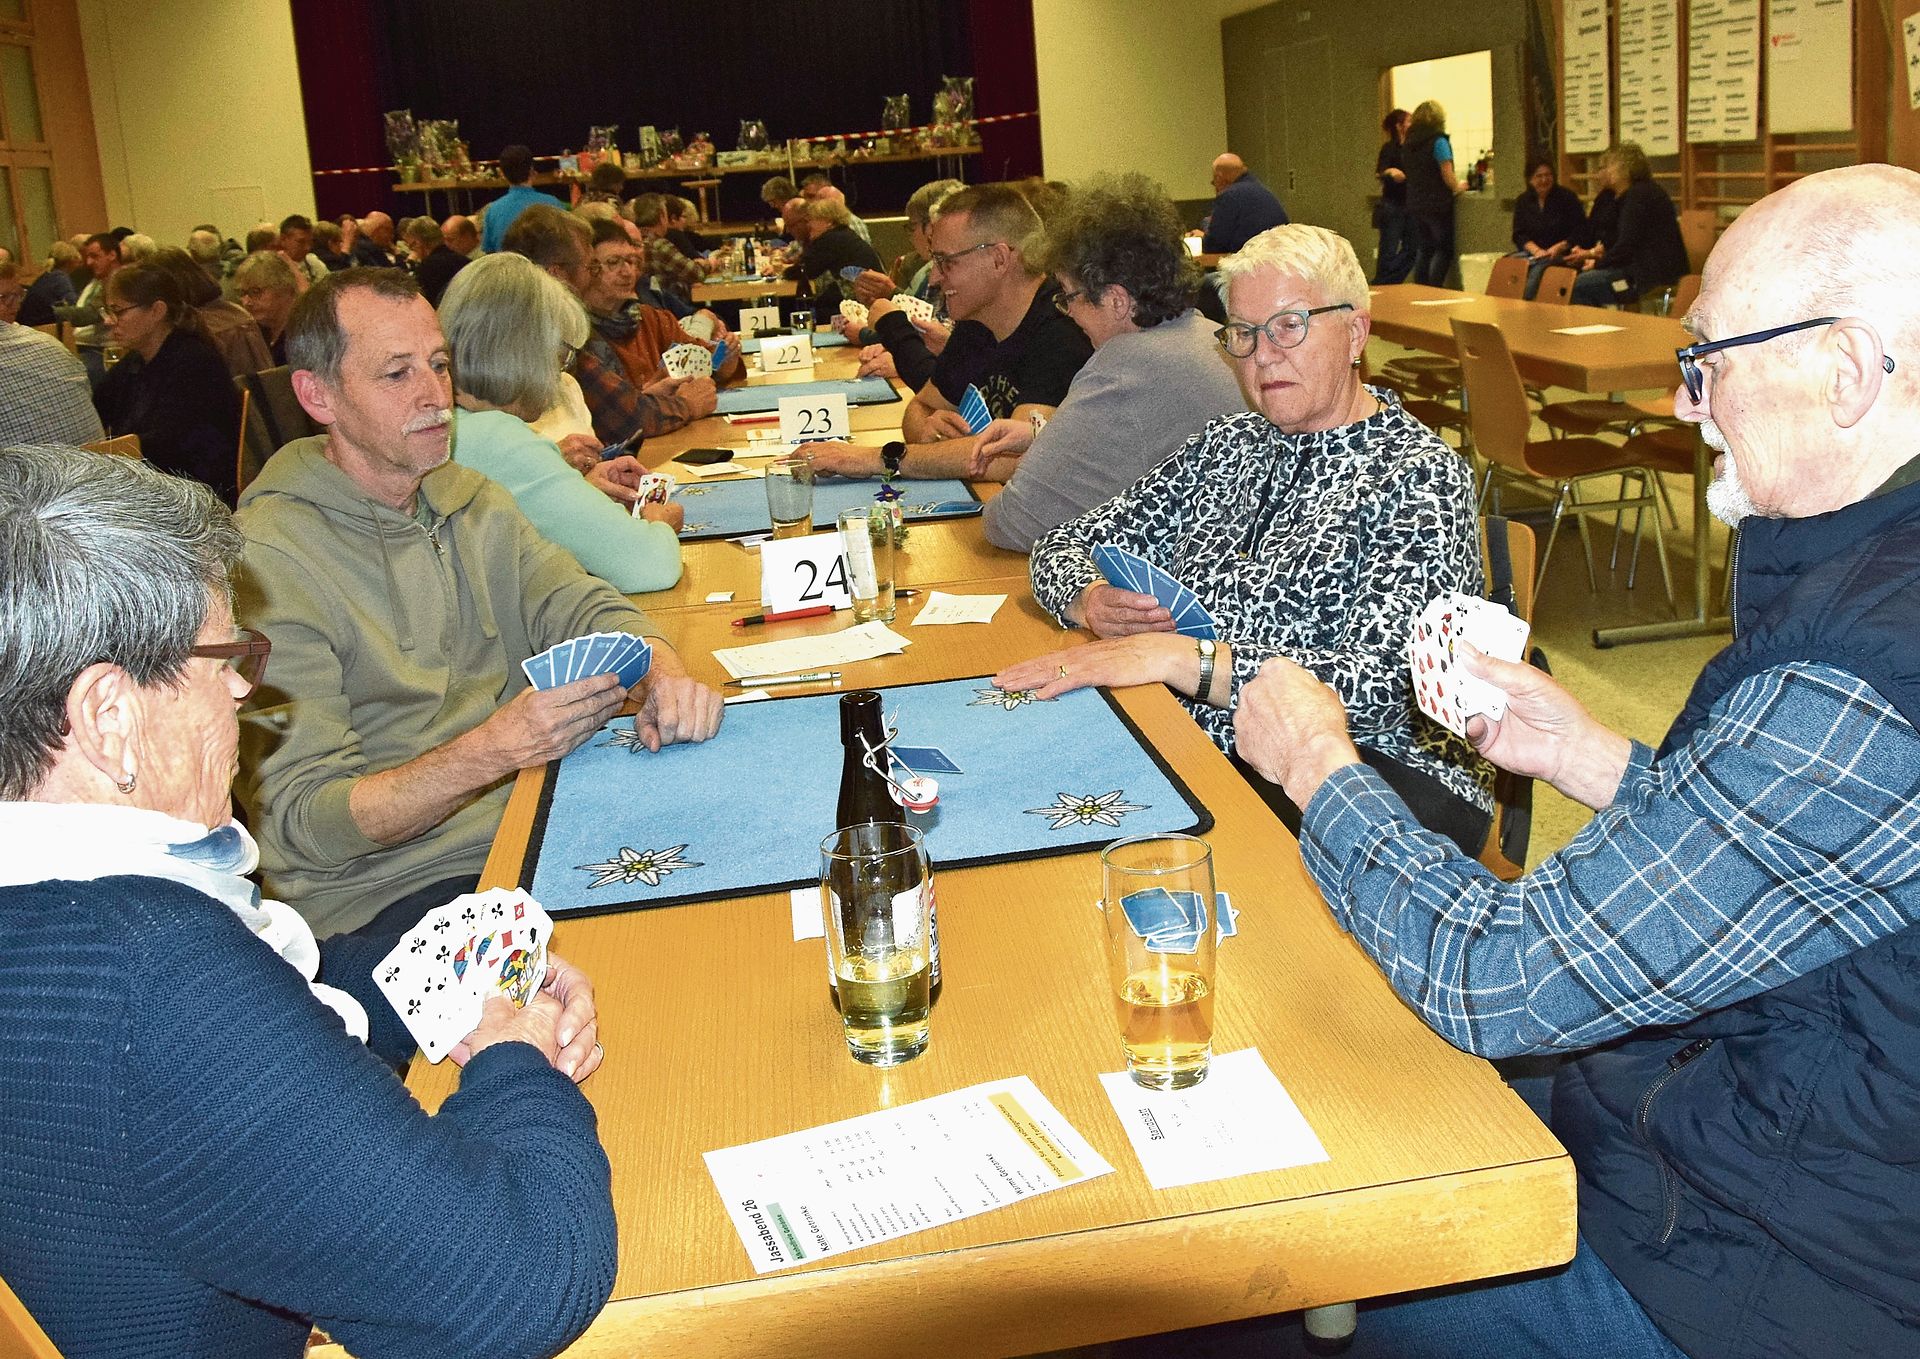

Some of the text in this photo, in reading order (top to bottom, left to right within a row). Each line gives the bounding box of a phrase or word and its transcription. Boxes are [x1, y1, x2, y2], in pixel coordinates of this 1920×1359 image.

[751, 315, 768, 331] 21
[777, 345, 801, 365] 22
[797, 407, 832, 435] 23
[794, 554, 850, 602] 24
[1138, 1107, 1162, 1141] Standblatt
[741, 1199, 784, 1263] Jassabend 26
